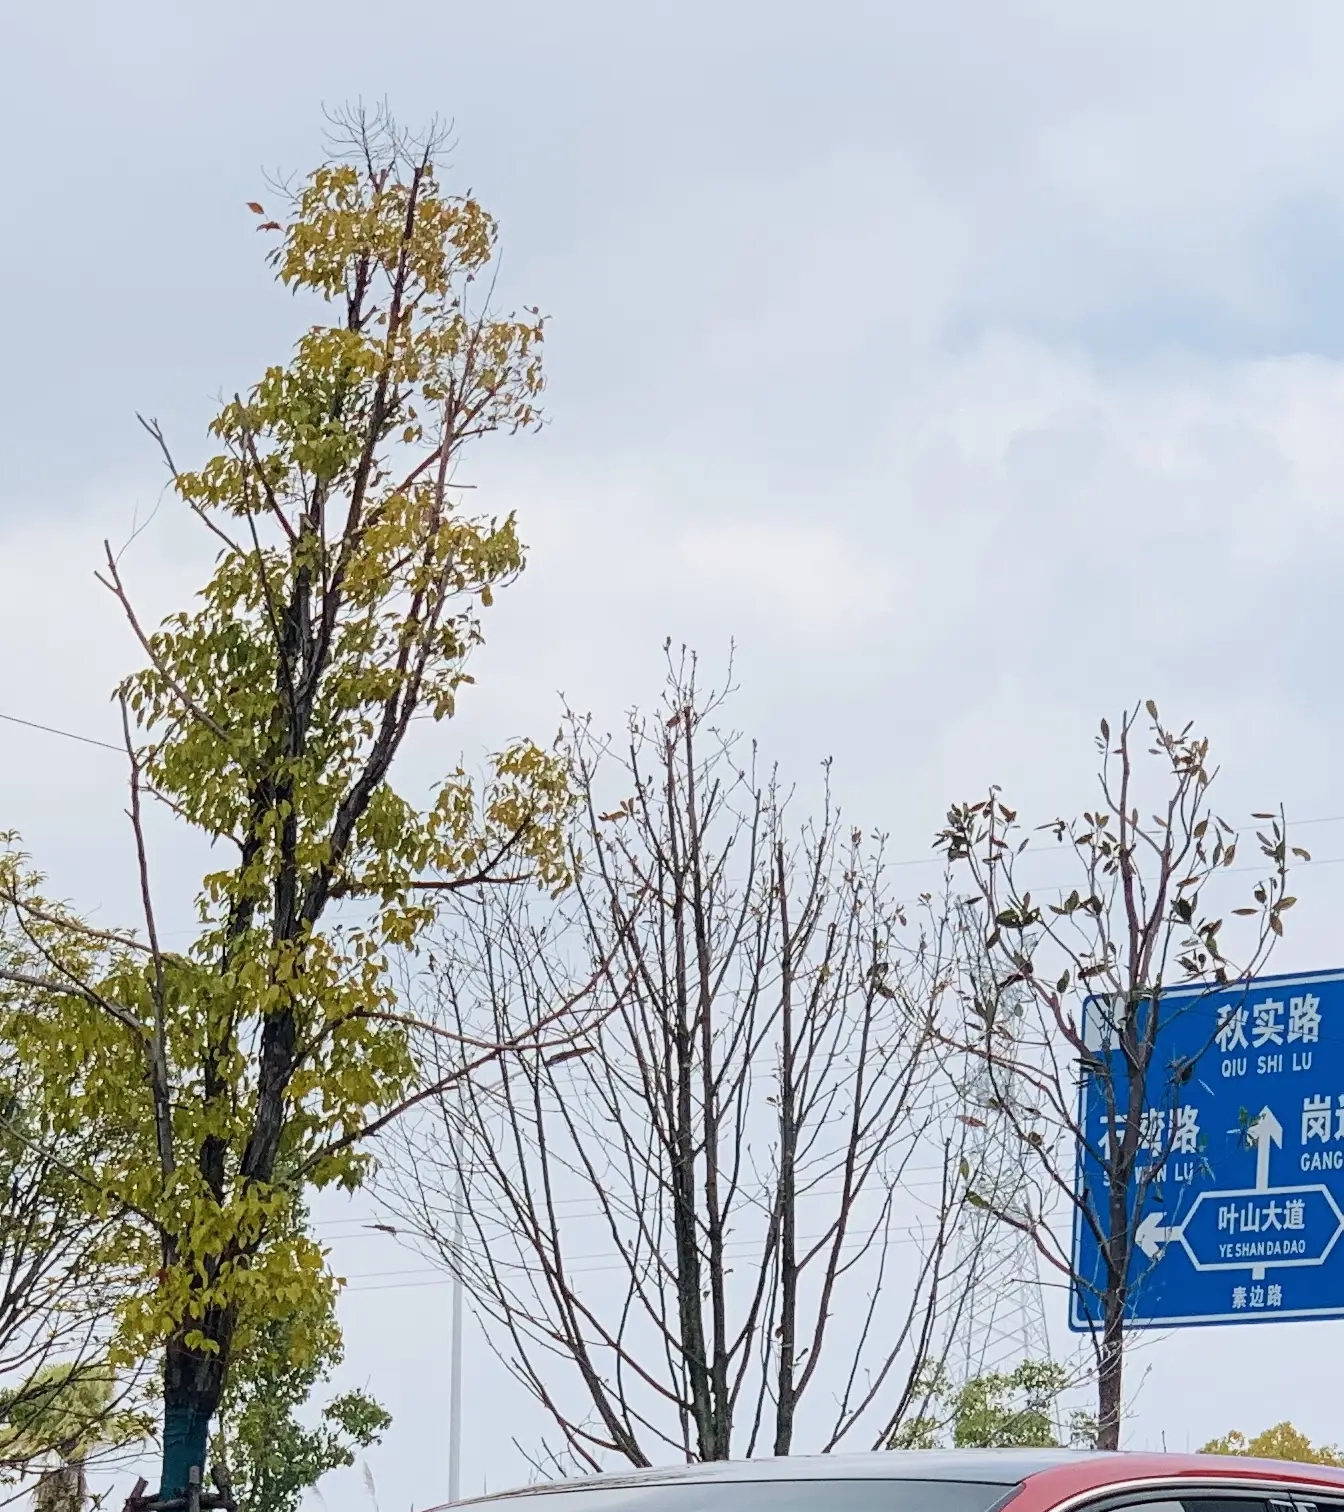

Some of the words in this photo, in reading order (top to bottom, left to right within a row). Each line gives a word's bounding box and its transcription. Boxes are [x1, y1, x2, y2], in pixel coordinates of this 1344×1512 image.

[1214, 992, 1323, 1053] 秋实路
[1221, 1056, 1247, 1078] QIU
[1256, 1053, 1283, 1075] SHI
[1292, 1051, 1312, 1072] LU
[1174, 1161, 1194, 1183] LU
[1300, 1149, 1344, 1172] GANG
[1218, 1198, 1306, 1236] 叶山大道
[1219, 1243, 1233, 1258] YE
[1234, 1241, 1265, 1258] SHAN
[1266, 1240, 1282, 1256] DA
[1283, 1239, 1306, 1255] DAO
